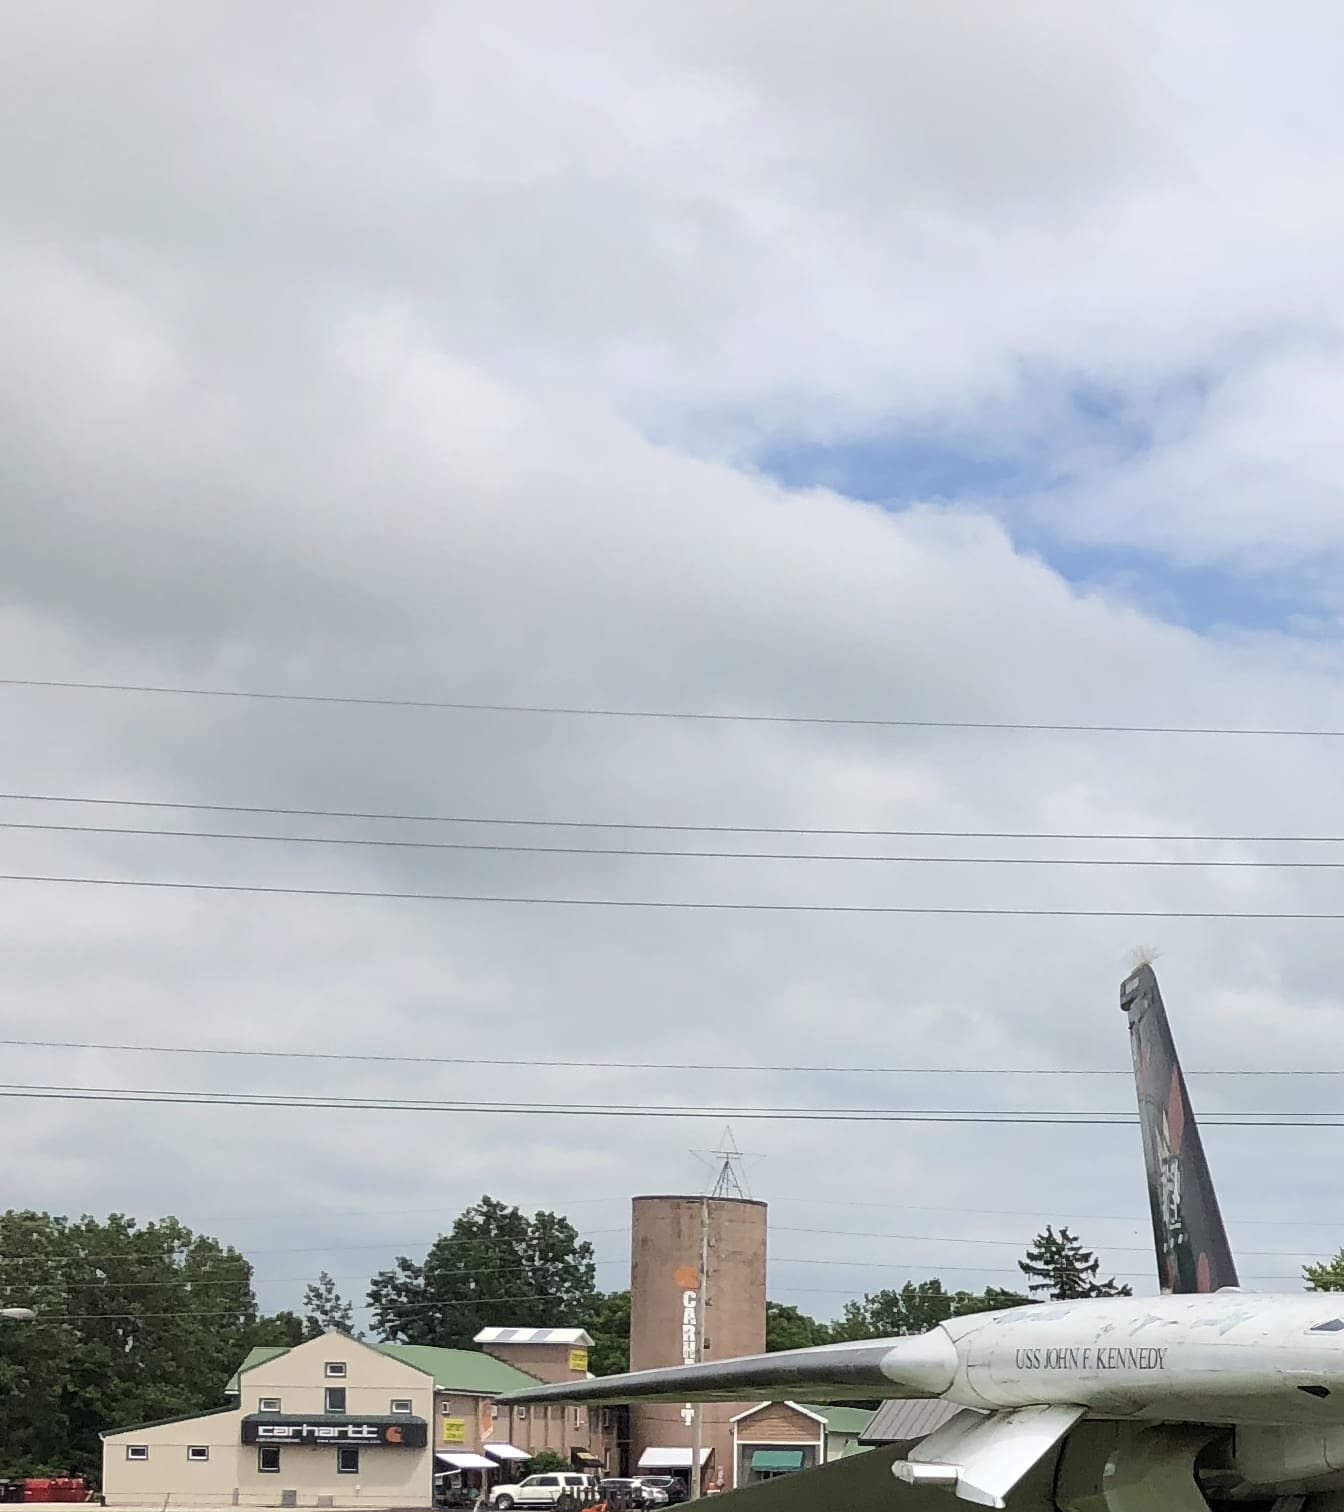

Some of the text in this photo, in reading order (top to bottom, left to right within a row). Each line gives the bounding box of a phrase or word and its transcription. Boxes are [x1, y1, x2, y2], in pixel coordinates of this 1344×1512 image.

[681, 1290, 697, 1427] CARHT
[1016, 1347, 1168, 1370] USS JOHN F. KENNEDY
[258, 1423, 378, 1438] carhartt
